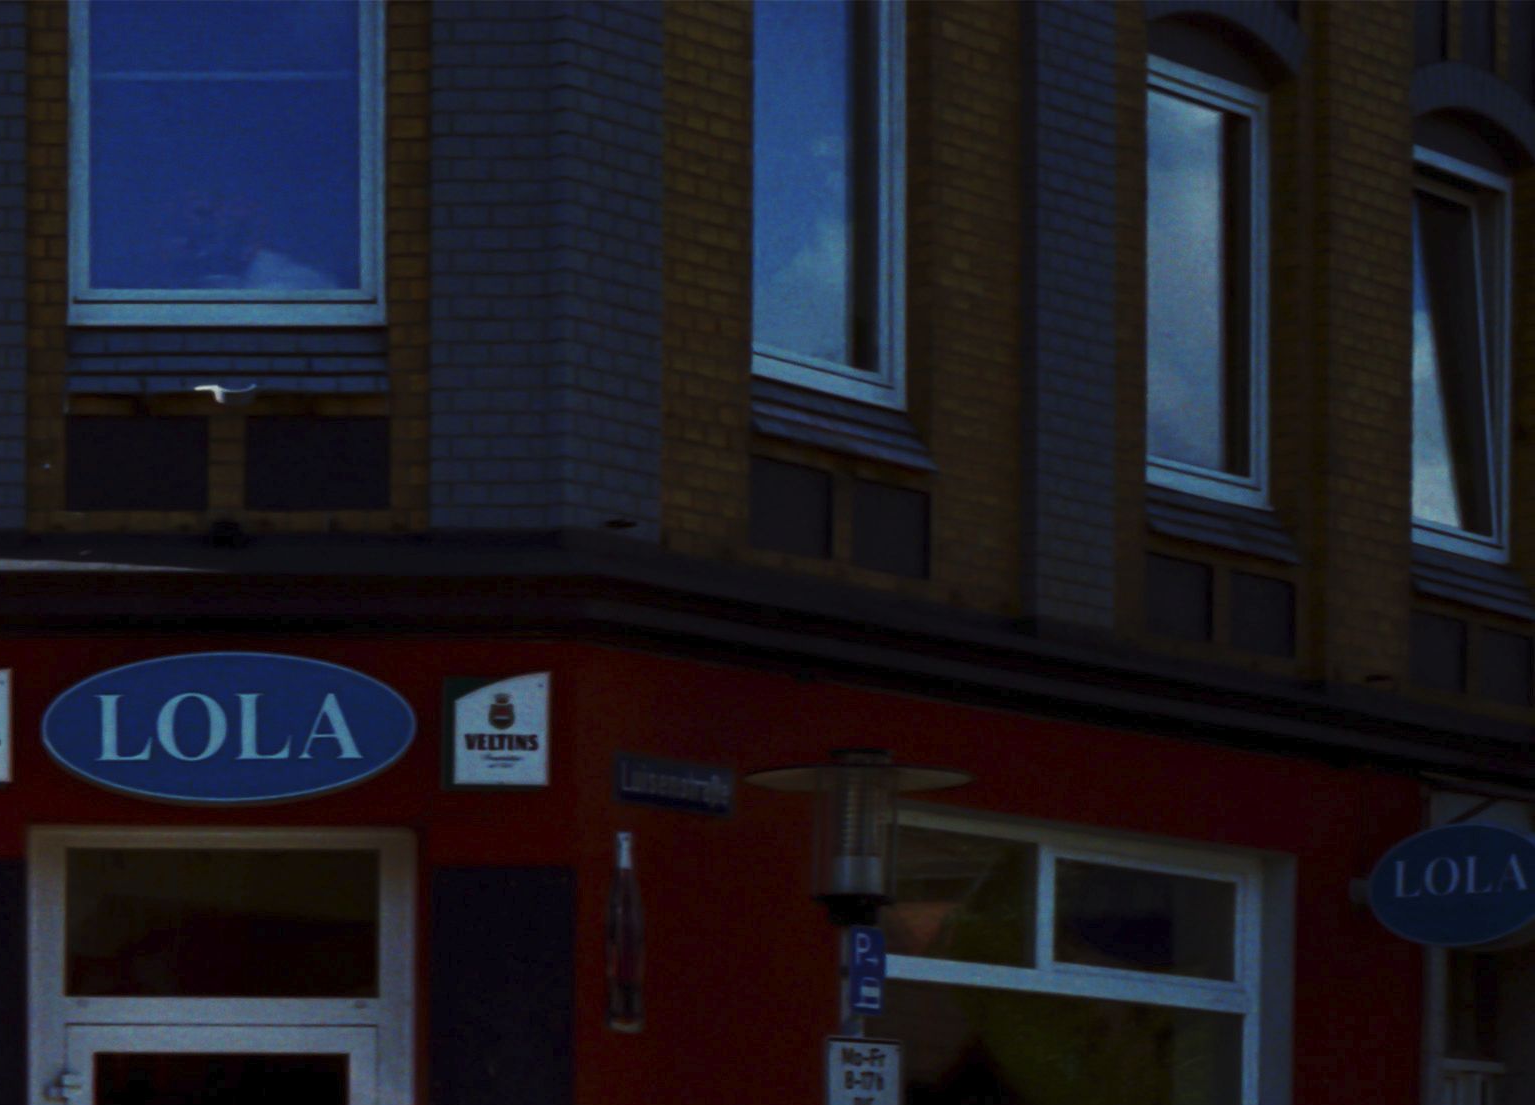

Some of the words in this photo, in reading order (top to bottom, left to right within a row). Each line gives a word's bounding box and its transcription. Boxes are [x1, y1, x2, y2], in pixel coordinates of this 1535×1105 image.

[94, 693, 365, 762] LOLA
[463, 733, 540, 752] VELTINS
[1394, 853, 1529, 898] LOLA
